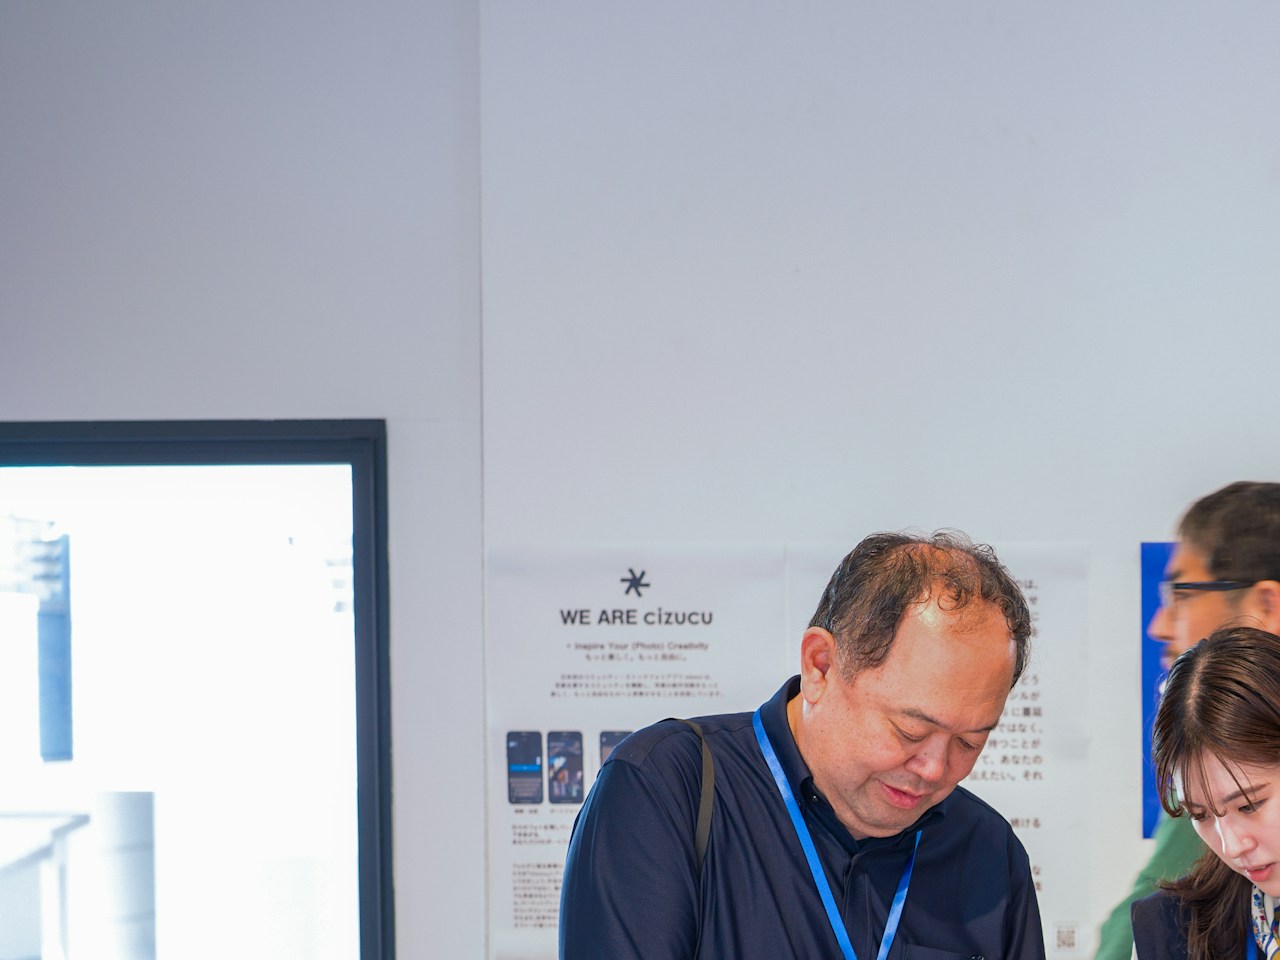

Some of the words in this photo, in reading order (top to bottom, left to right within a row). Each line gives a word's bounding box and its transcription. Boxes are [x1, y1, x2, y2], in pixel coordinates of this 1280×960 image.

[560, 609, 591, 625] WE
[598, 609, 638, 625] ARE
[643, 607, 713, 625] cizucu
